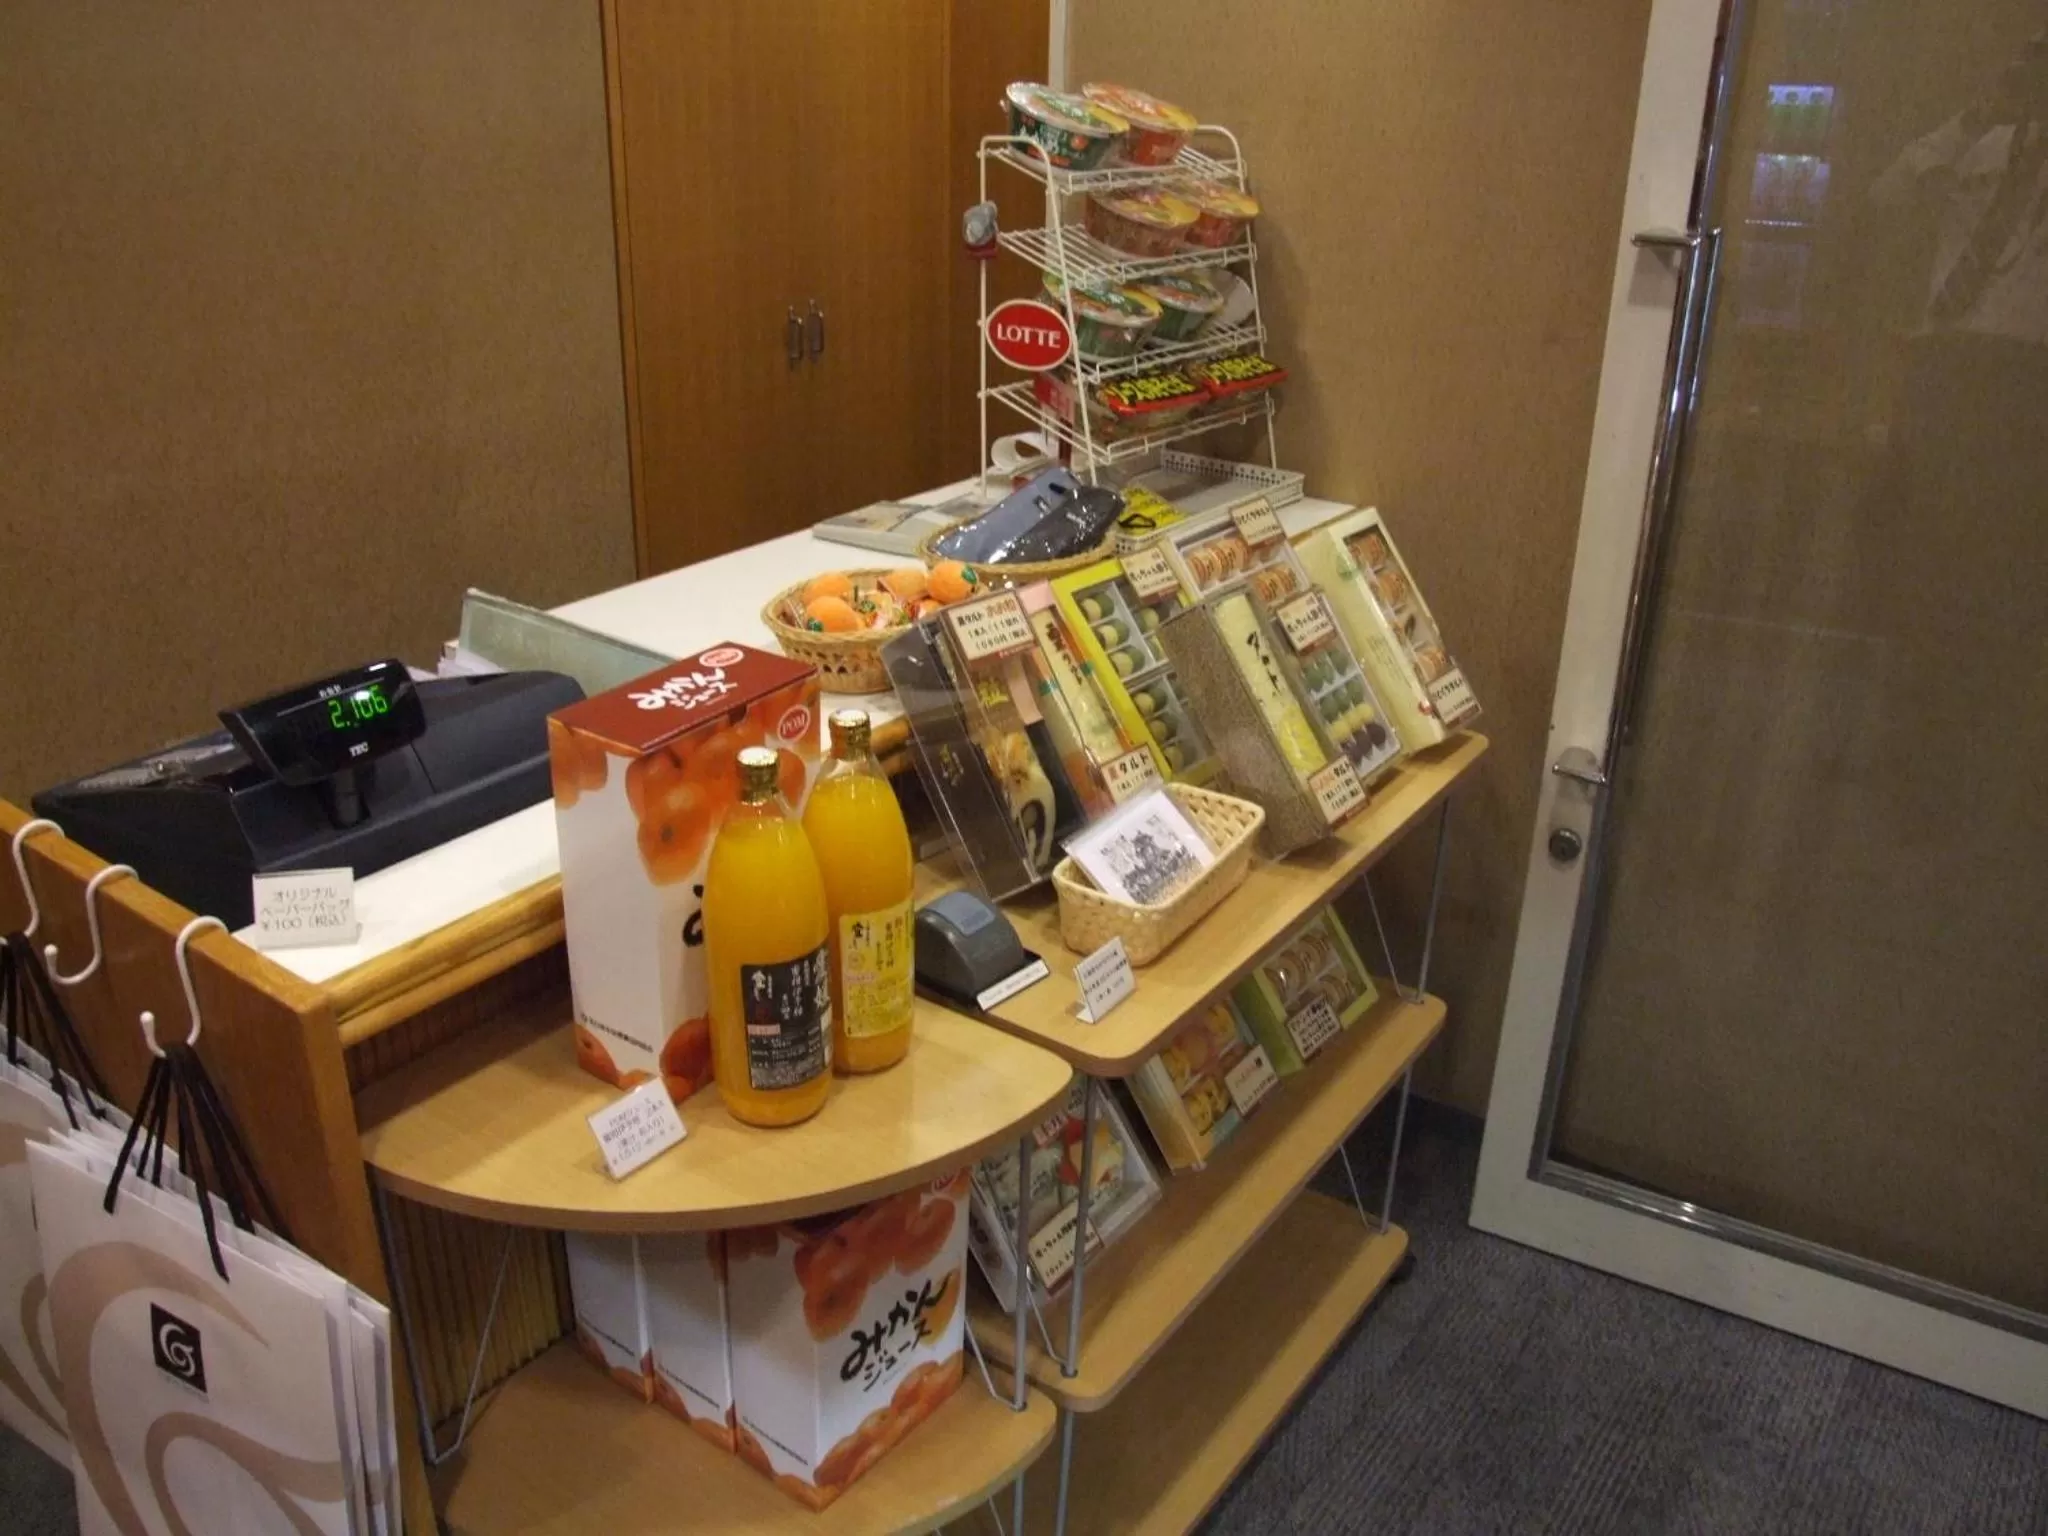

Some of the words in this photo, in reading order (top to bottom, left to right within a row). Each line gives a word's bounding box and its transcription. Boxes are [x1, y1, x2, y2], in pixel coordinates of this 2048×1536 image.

[997, 322, 1062, 349] LOTTE
[839, 1271, 955, 1382] みかん
[862, 1318, 933, 1393] ジュース
